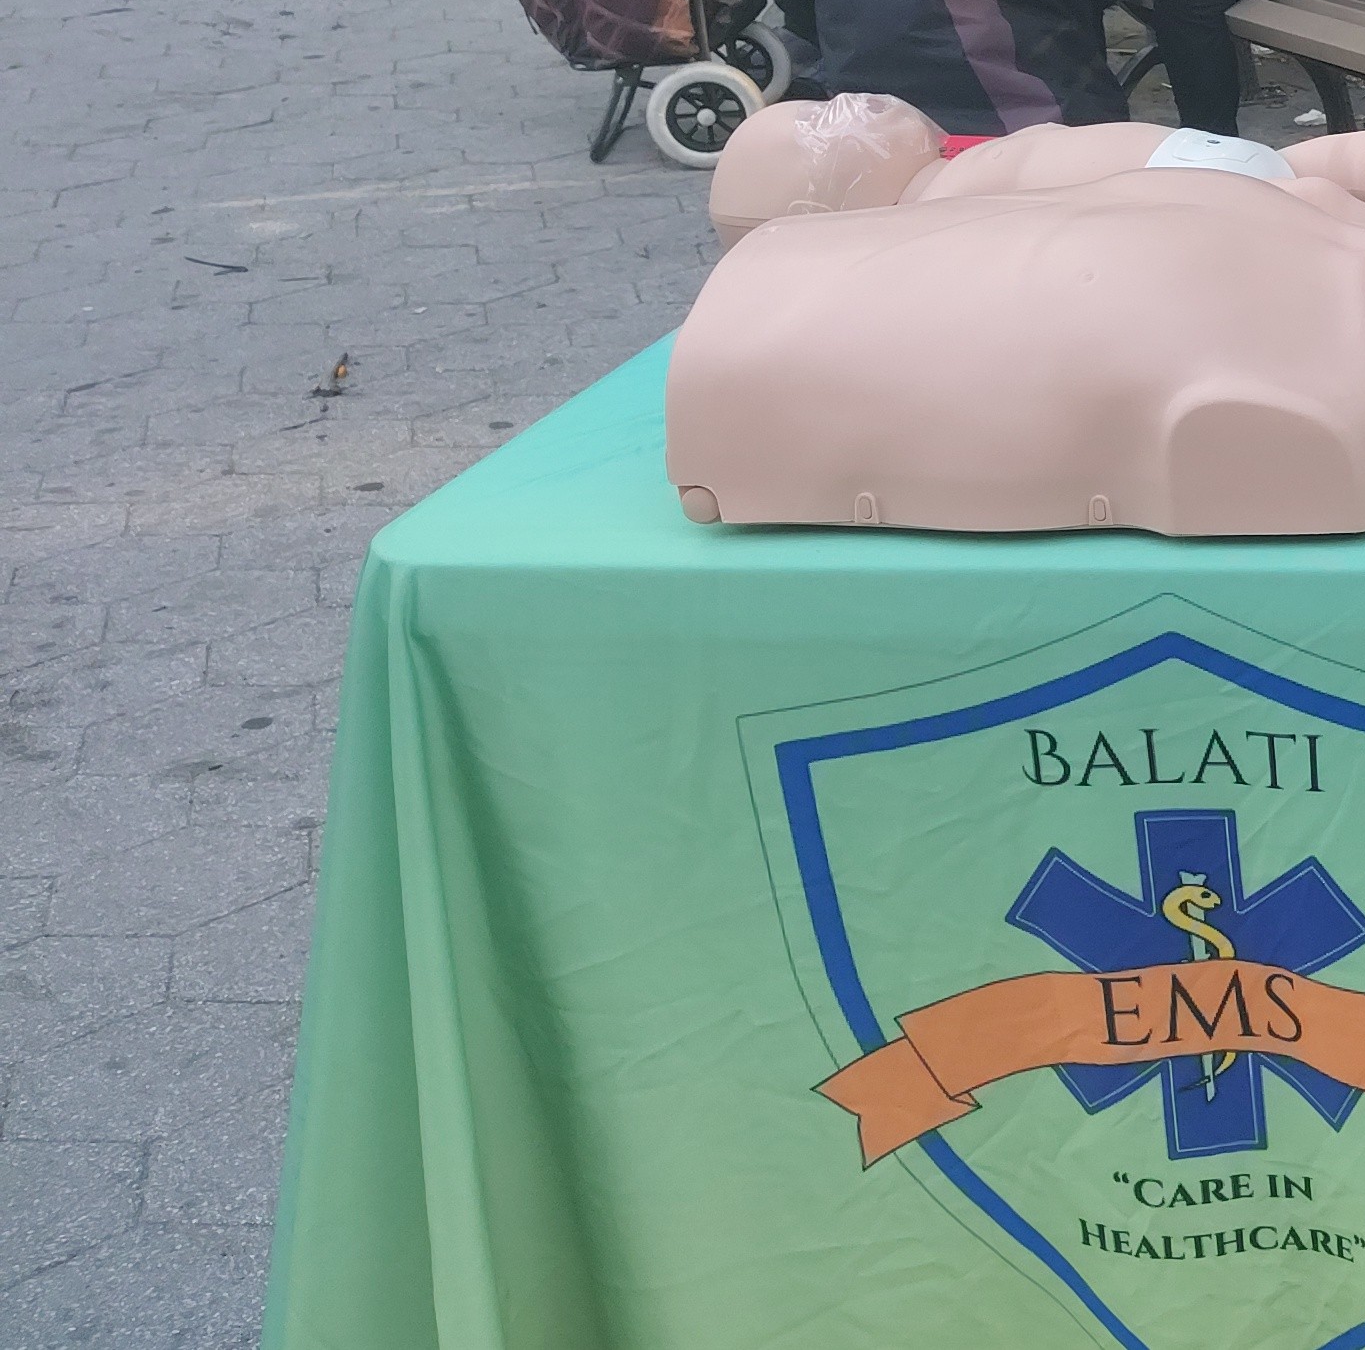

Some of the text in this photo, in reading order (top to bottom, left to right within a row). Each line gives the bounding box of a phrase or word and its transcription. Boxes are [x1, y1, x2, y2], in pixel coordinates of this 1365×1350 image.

[1023, 728, 1325, 792] BALATI
[1097, 972, 1303, 1047] EMS
[1268, 1173, 1314, 1202] IN
